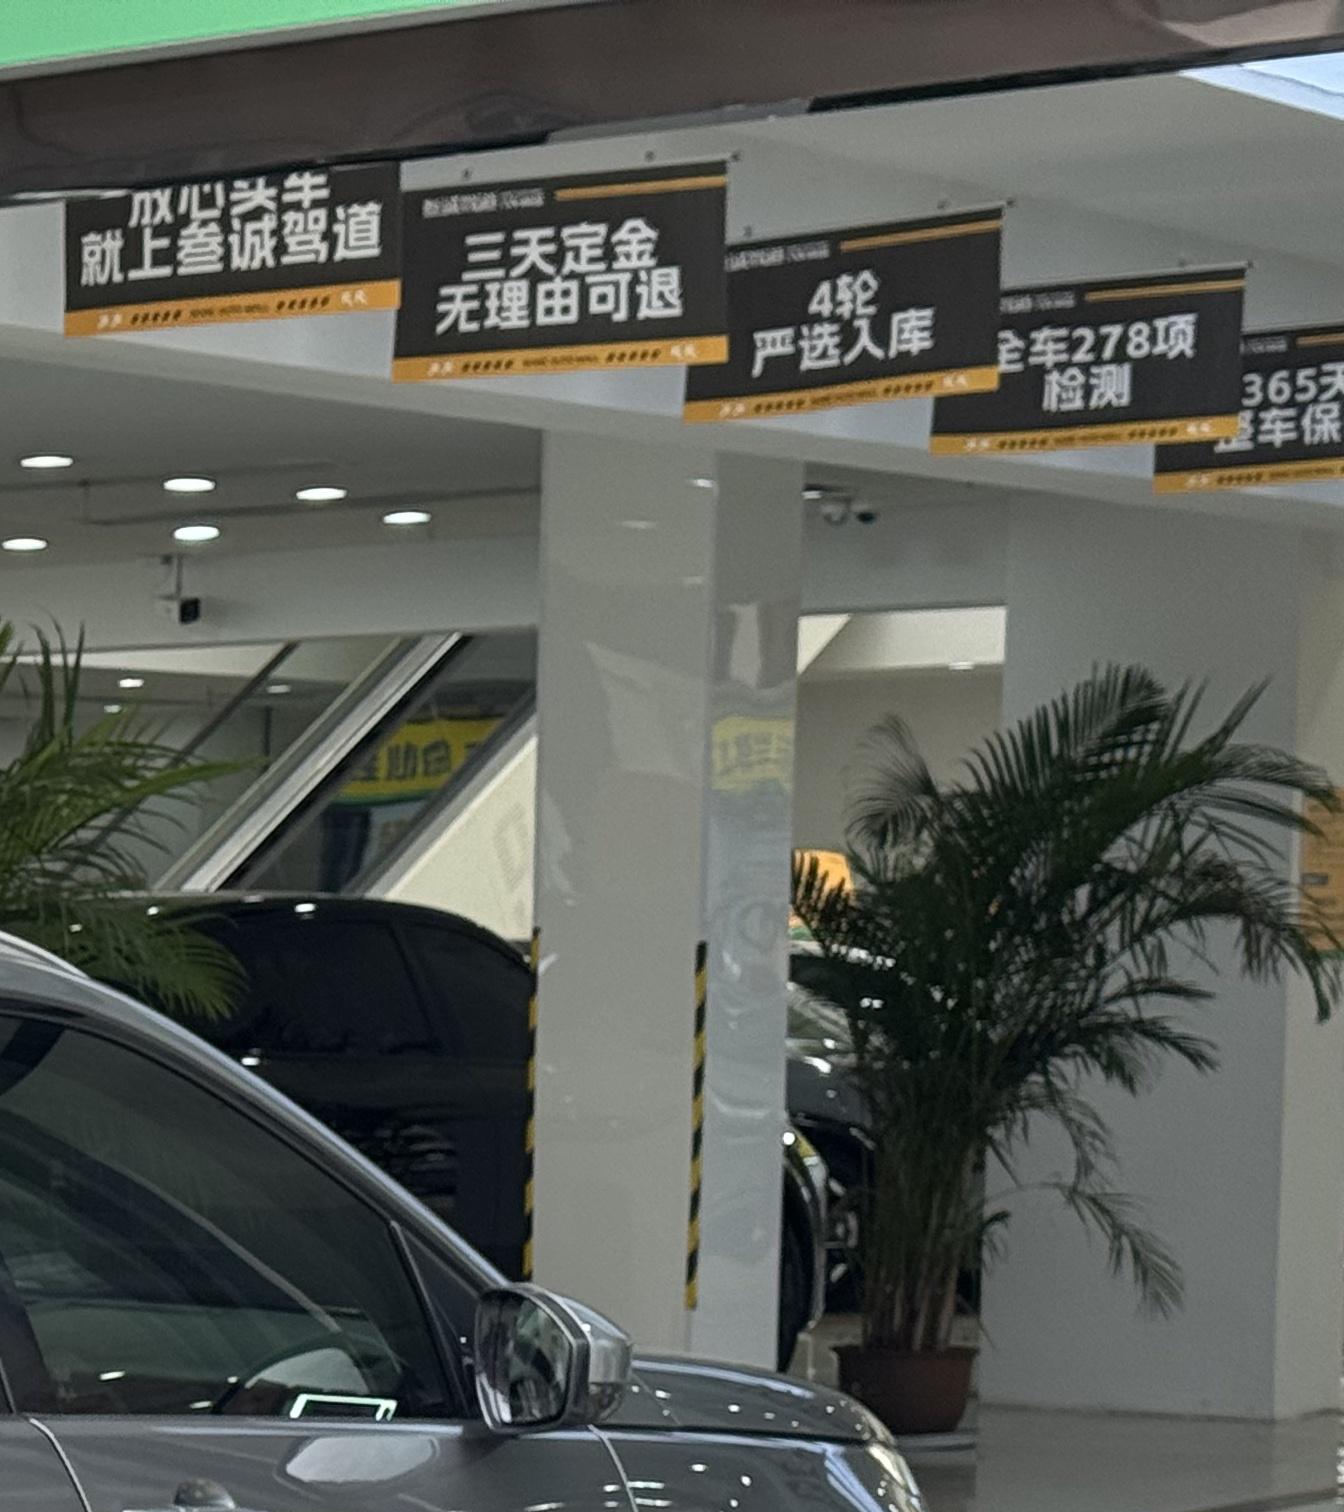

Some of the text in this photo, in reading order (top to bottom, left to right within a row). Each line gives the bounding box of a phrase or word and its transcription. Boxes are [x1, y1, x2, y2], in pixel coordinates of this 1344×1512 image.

[80, 201, 383, 287] 就上叁诚驾道
[461, 217, 659, 282] 三天定金
[435, 266, 683, 335] 无理由可退
[808, 268, 880, 320] 4轮
[751, 306, 935, 378] 严选入库
[1042, 362, 1133, 412] 检测
